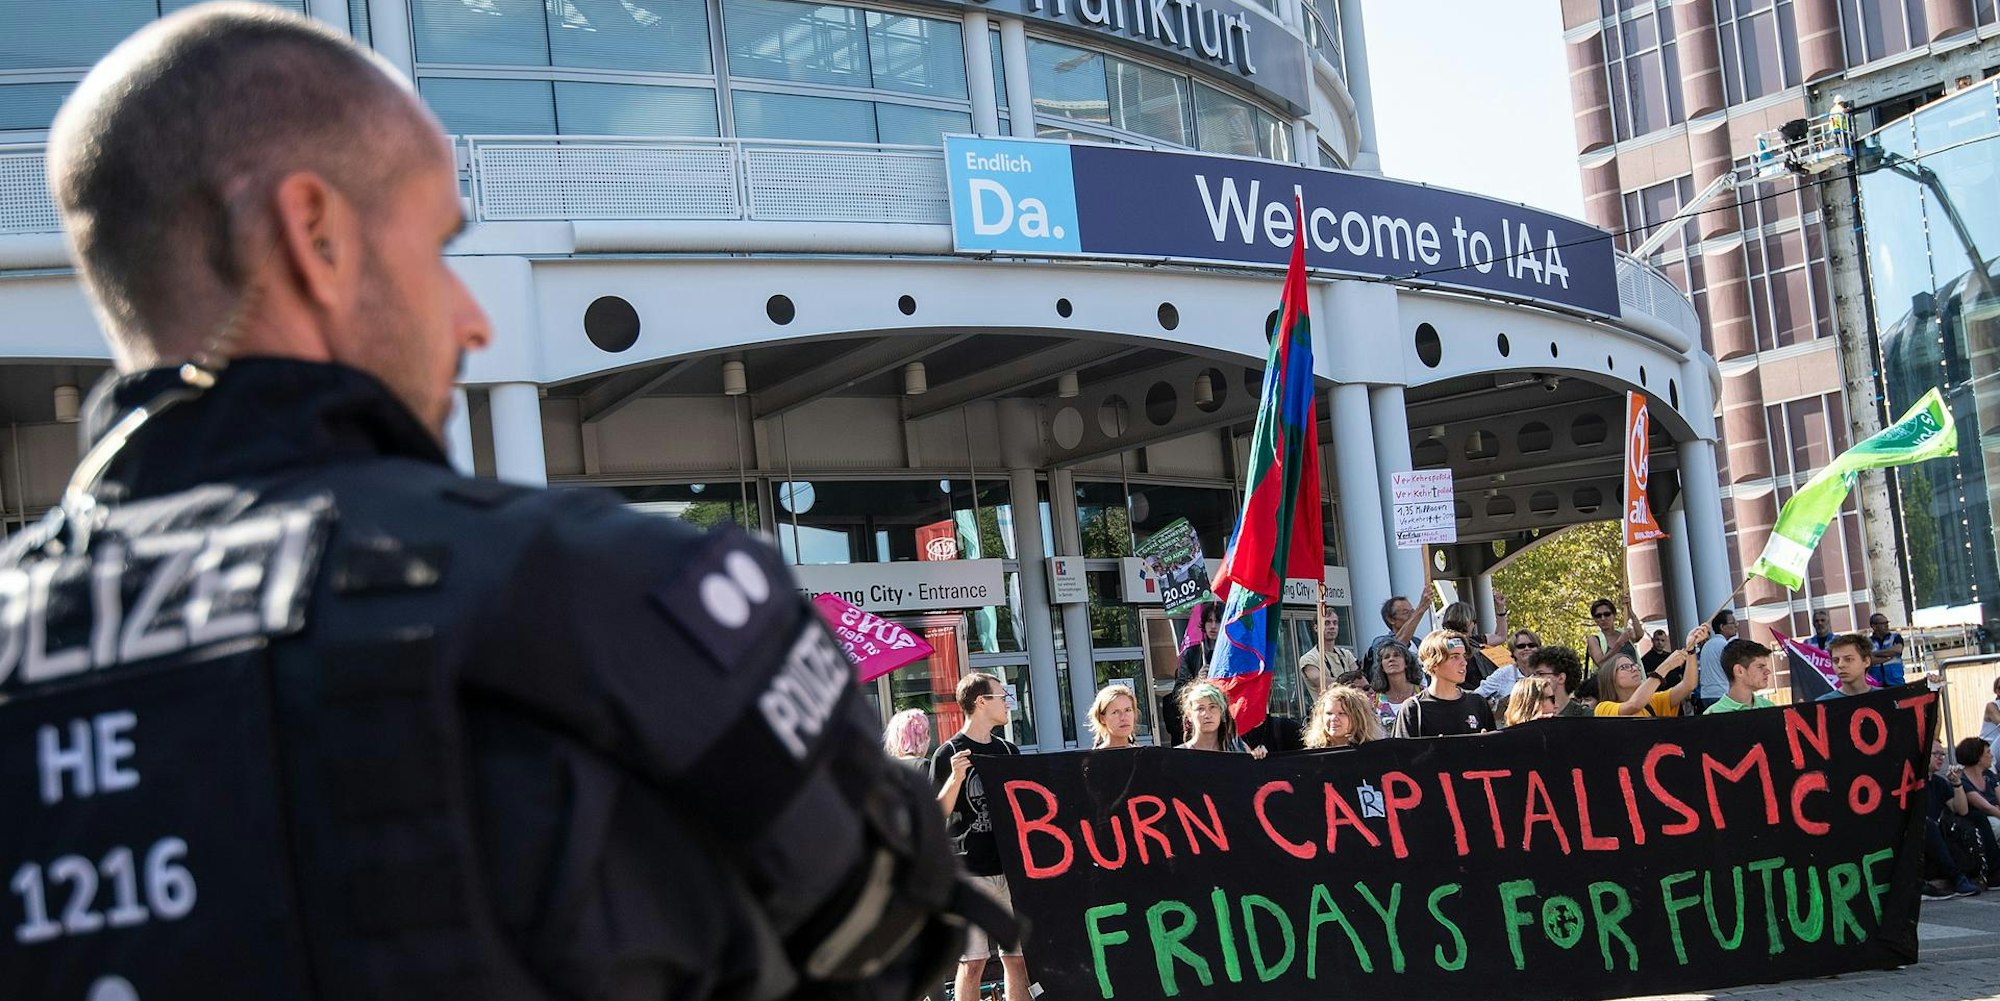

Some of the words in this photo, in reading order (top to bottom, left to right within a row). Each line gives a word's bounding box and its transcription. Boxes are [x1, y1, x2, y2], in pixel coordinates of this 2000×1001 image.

[965, 151, 1032, 173] Endlich
[969, 178, 1065, 239] Da.
[1194, 174, 1442, 266] Welcome
[1452, 216, 1493, 274] to
[1502, 218, 1570, 290] IAA
[870, 584, 903, 605] City
[918, 583, 987, 600] Entrance
[1163, 579, 1200, 603] 20.09.
[1296, 582, 1311, 600] City
[37, 710, 141, 804] HE
[1783, 692, 1936, 770] NOT
[1004, 779, 1230, 879] BURN
[10, 836, 198, 943] 1216
[1084, 880, 1468, 999] FRIDAYS
[1499, 878, 1639, 972] FOR
